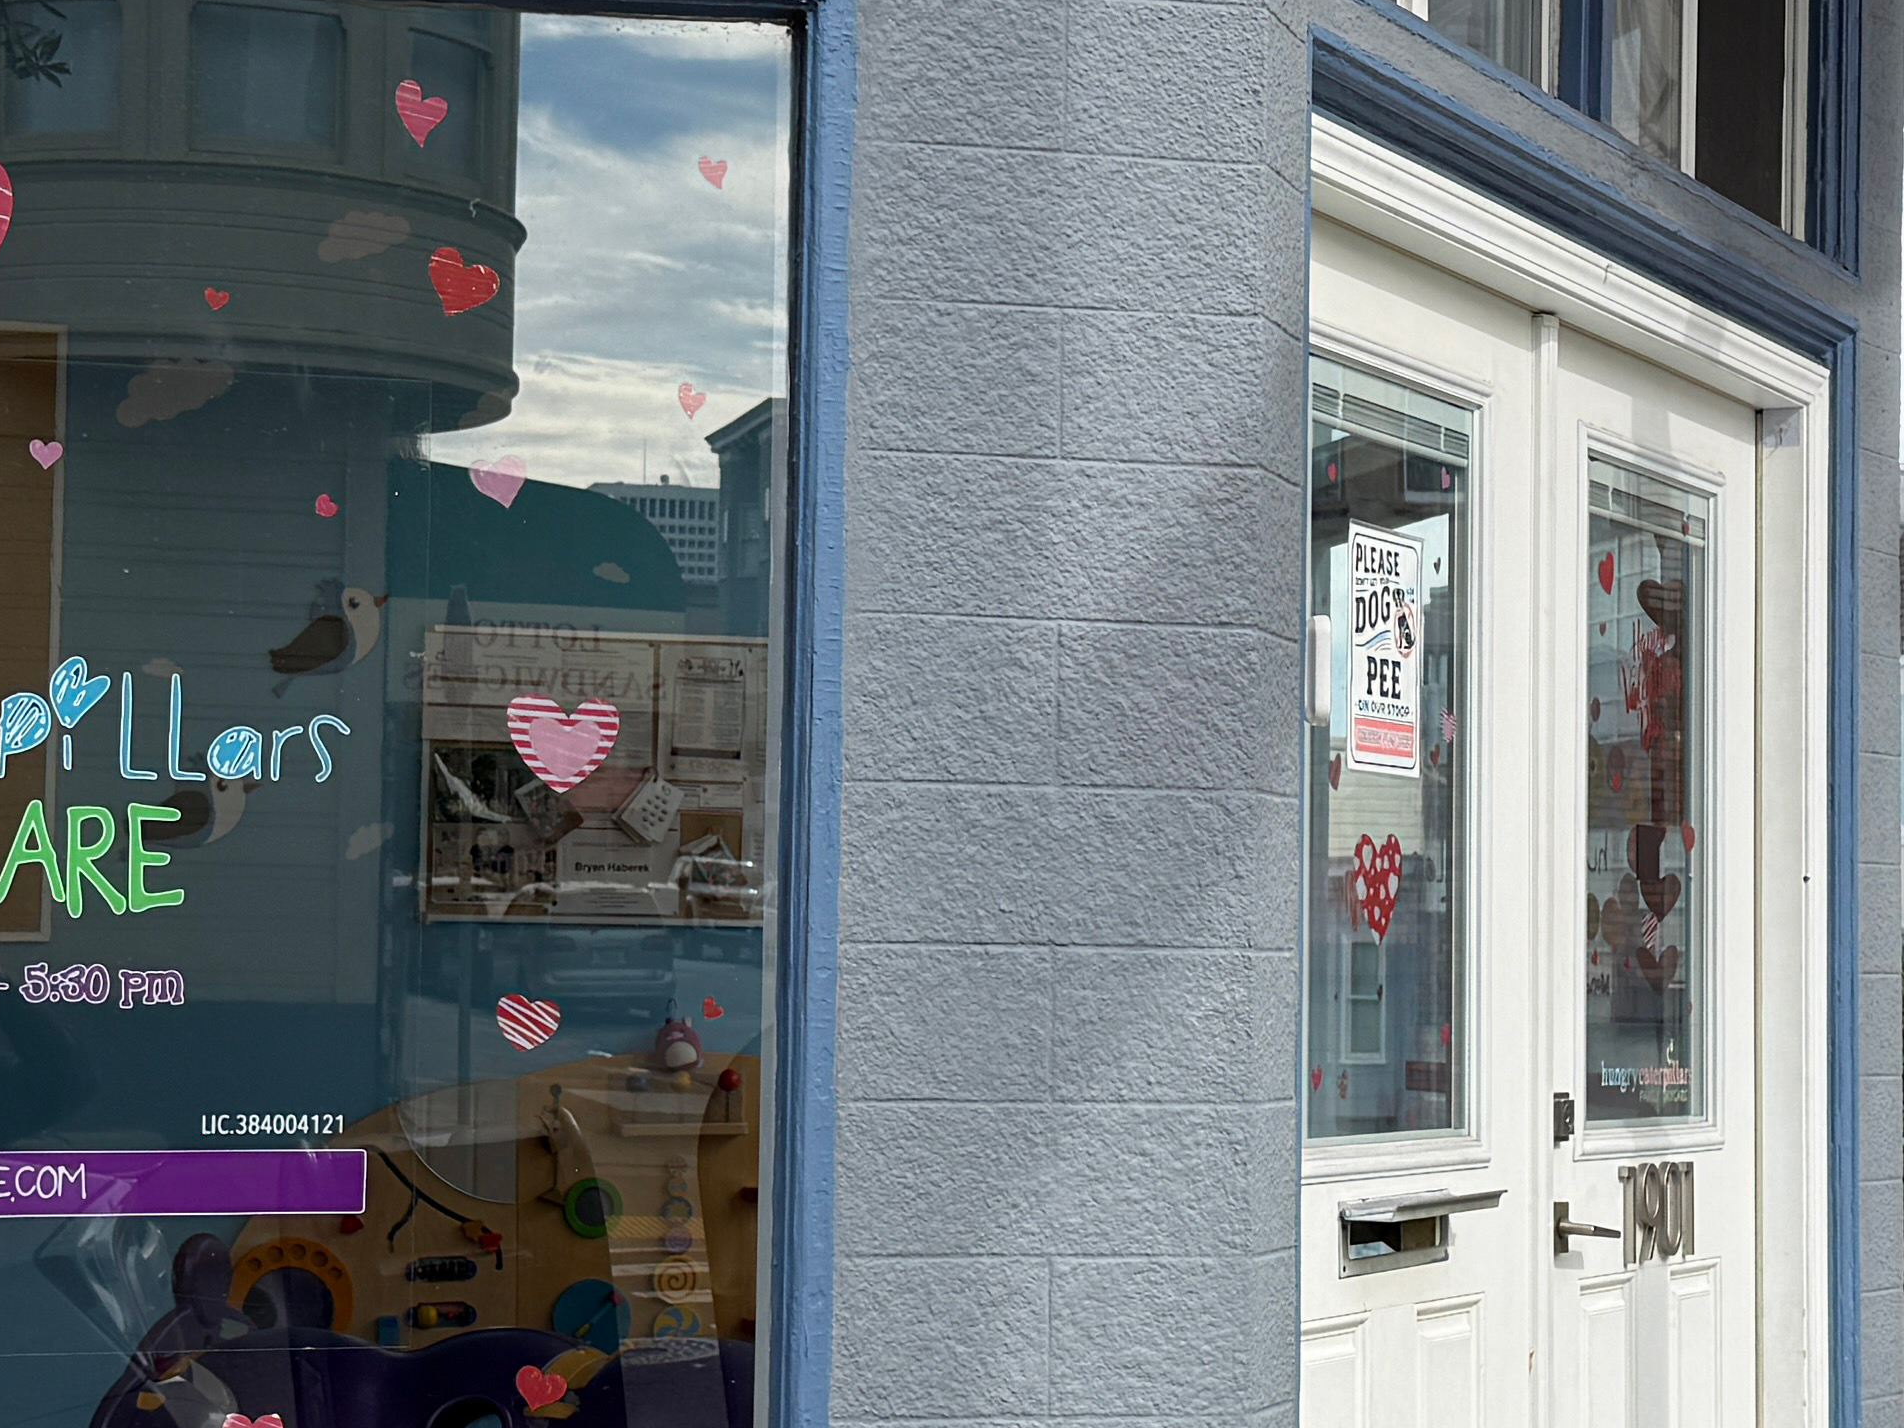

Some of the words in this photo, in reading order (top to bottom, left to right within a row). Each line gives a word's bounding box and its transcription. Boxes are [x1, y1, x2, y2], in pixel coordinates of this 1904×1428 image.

[1355, 542, 1400, 577] PLEASE
[1355, 585, 1391, 634] DOG
[1366, 656, 1401, 700] PEE
[19, 963, 111, 1005] 5:30
[118, 969, 185, 1009] pm
[201, 1114, 344, 1136] LIC.384004121
[1617, 1161, 1695, 1266] 1901
